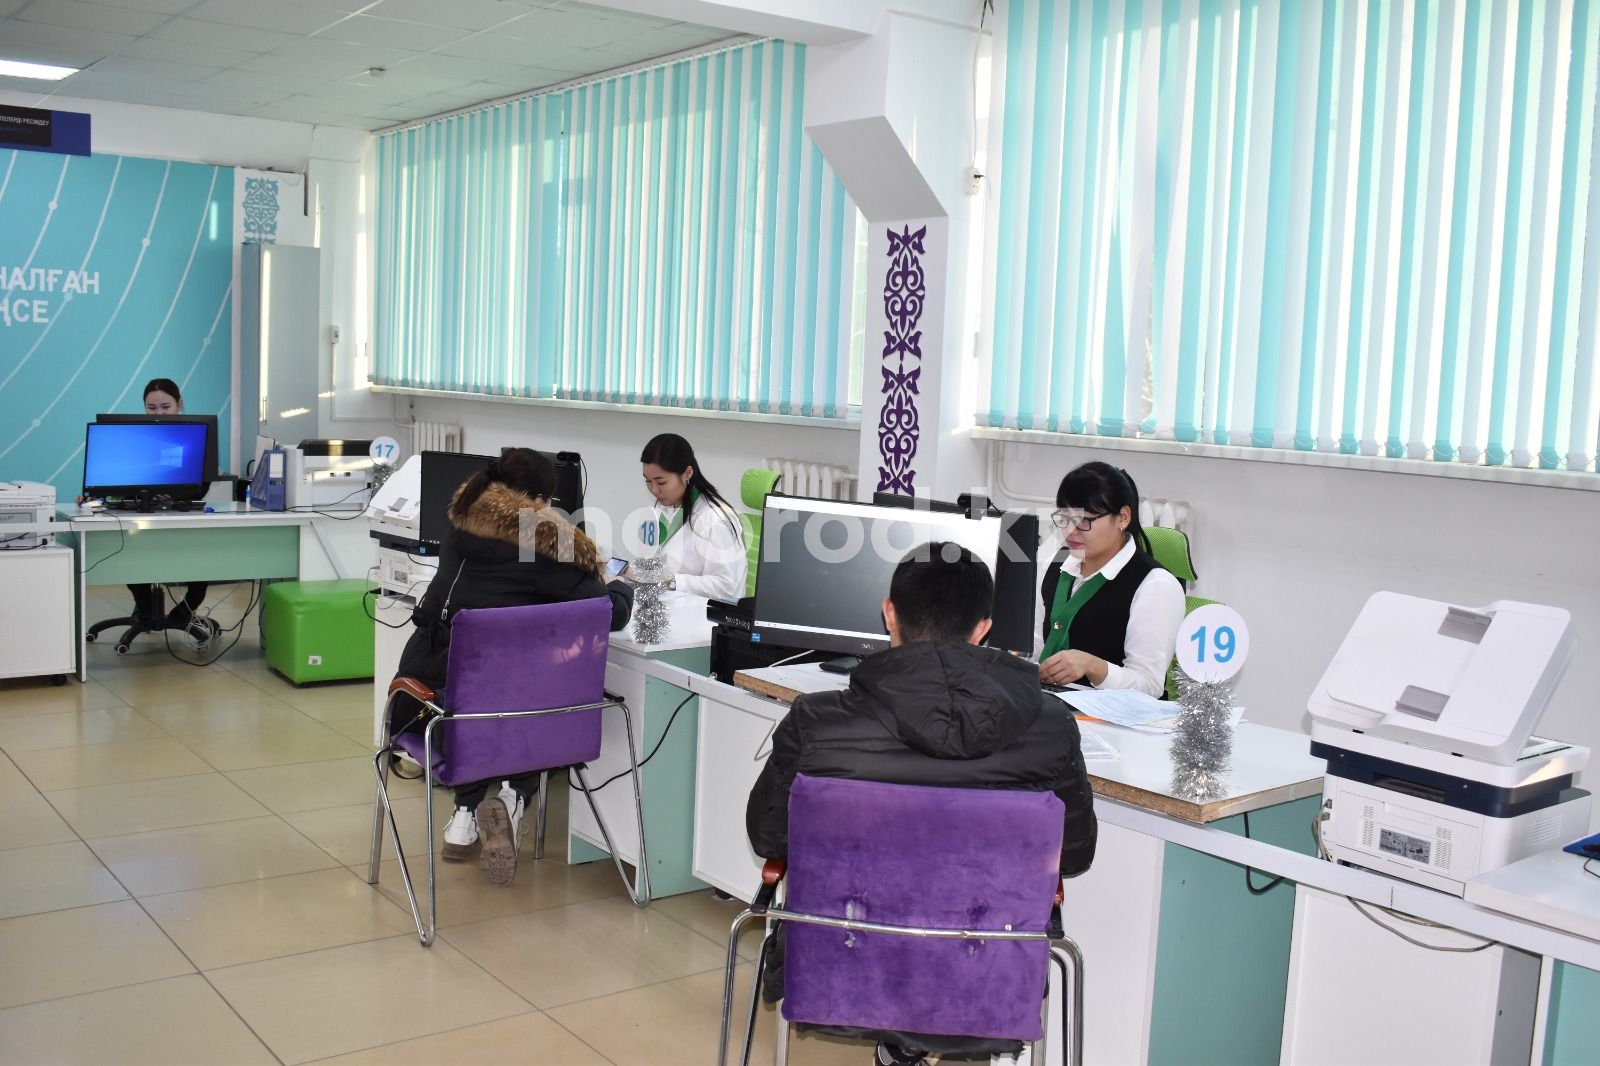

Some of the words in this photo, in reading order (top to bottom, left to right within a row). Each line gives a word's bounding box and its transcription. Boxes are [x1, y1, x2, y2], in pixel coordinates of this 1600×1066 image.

[375, 444, 394, 458] 17
[641, 520, 655, 546] 18
[1190, 626, 1236, 663] 19
